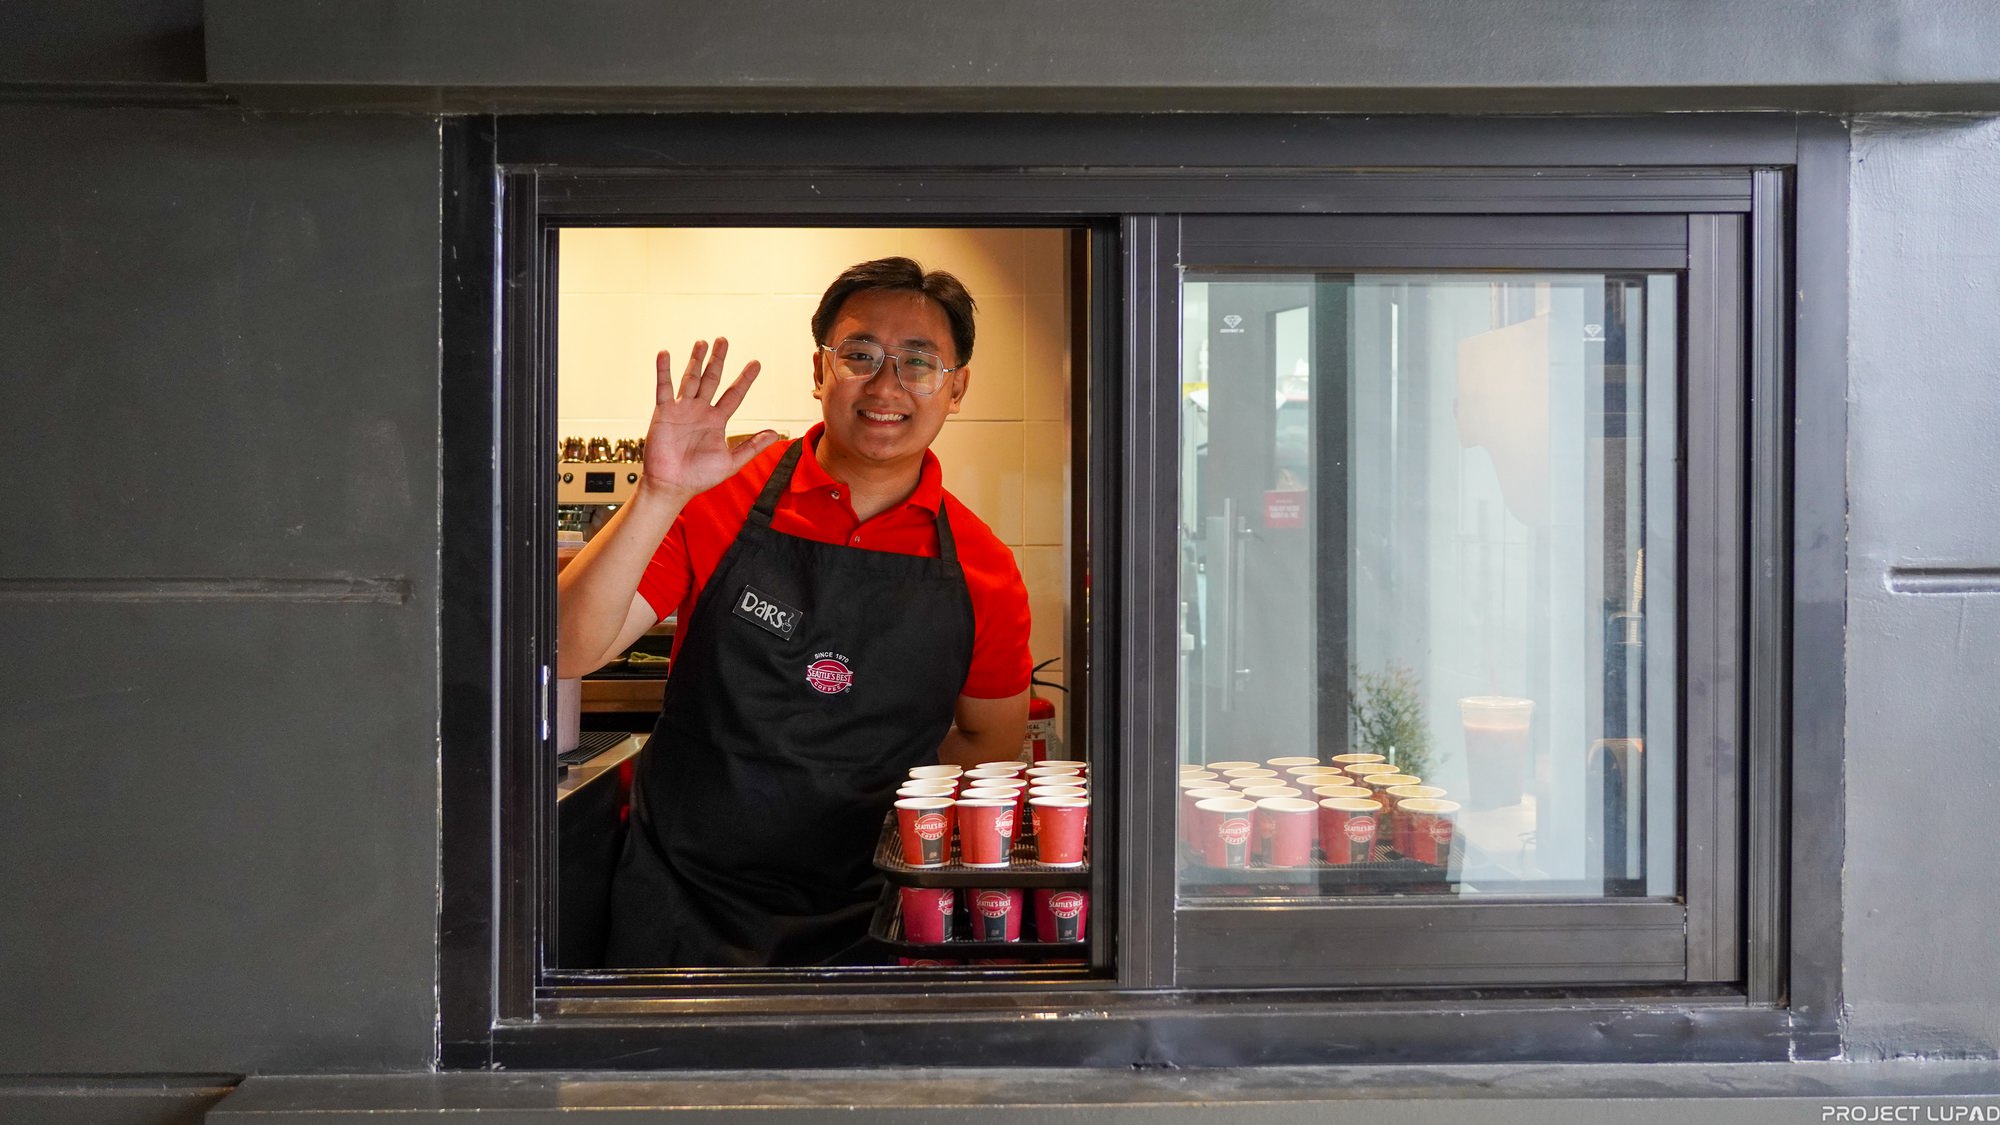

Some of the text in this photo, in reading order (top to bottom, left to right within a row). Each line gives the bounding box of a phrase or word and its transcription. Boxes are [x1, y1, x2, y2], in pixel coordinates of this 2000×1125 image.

[814, 651, 850, 664] SINCE 1970
[807, 668, 852, 683] SEATTLE'S BEST
[814, 681, 842, 692] COFFEE
[976, 899, 1011, 908] SEATTLE'S BEST
[1048, 900, 1073, 908] SEATTLE'S
